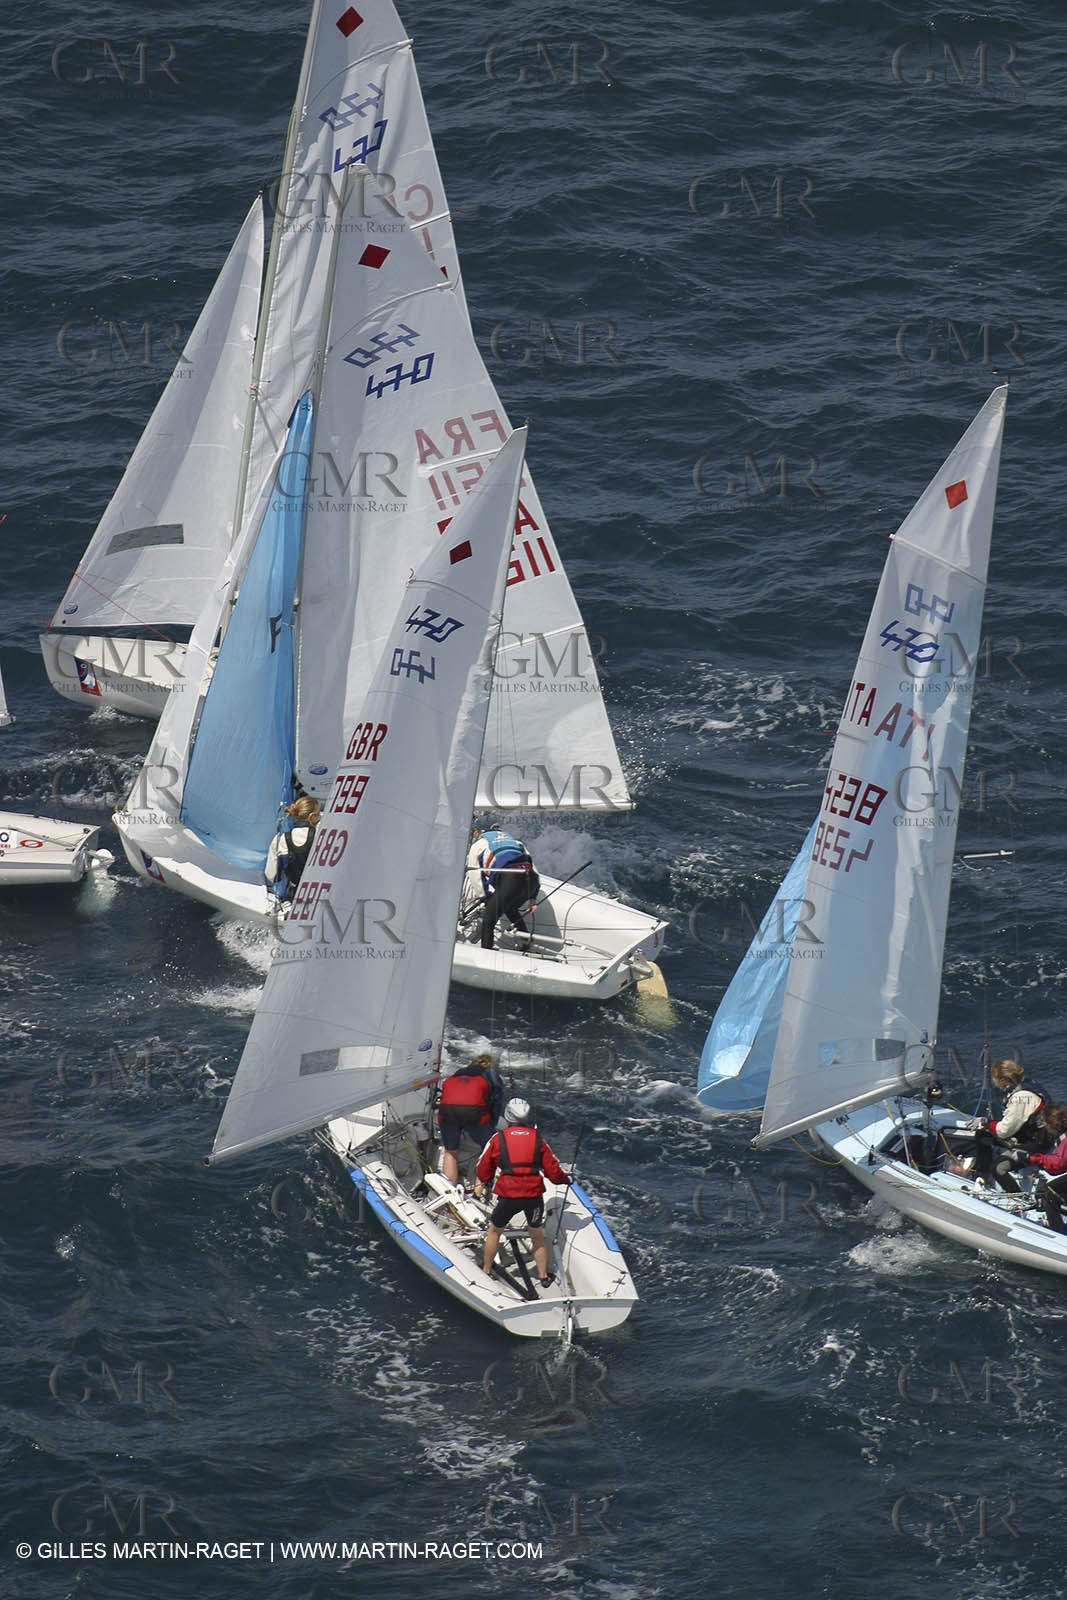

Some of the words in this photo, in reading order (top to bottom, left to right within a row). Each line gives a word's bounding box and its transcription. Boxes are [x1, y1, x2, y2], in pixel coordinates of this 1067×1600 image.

[365, 352, 435, 399] 470
[843, 680, 877, 727] ITA
[346, 722, 388, 761] GBR
